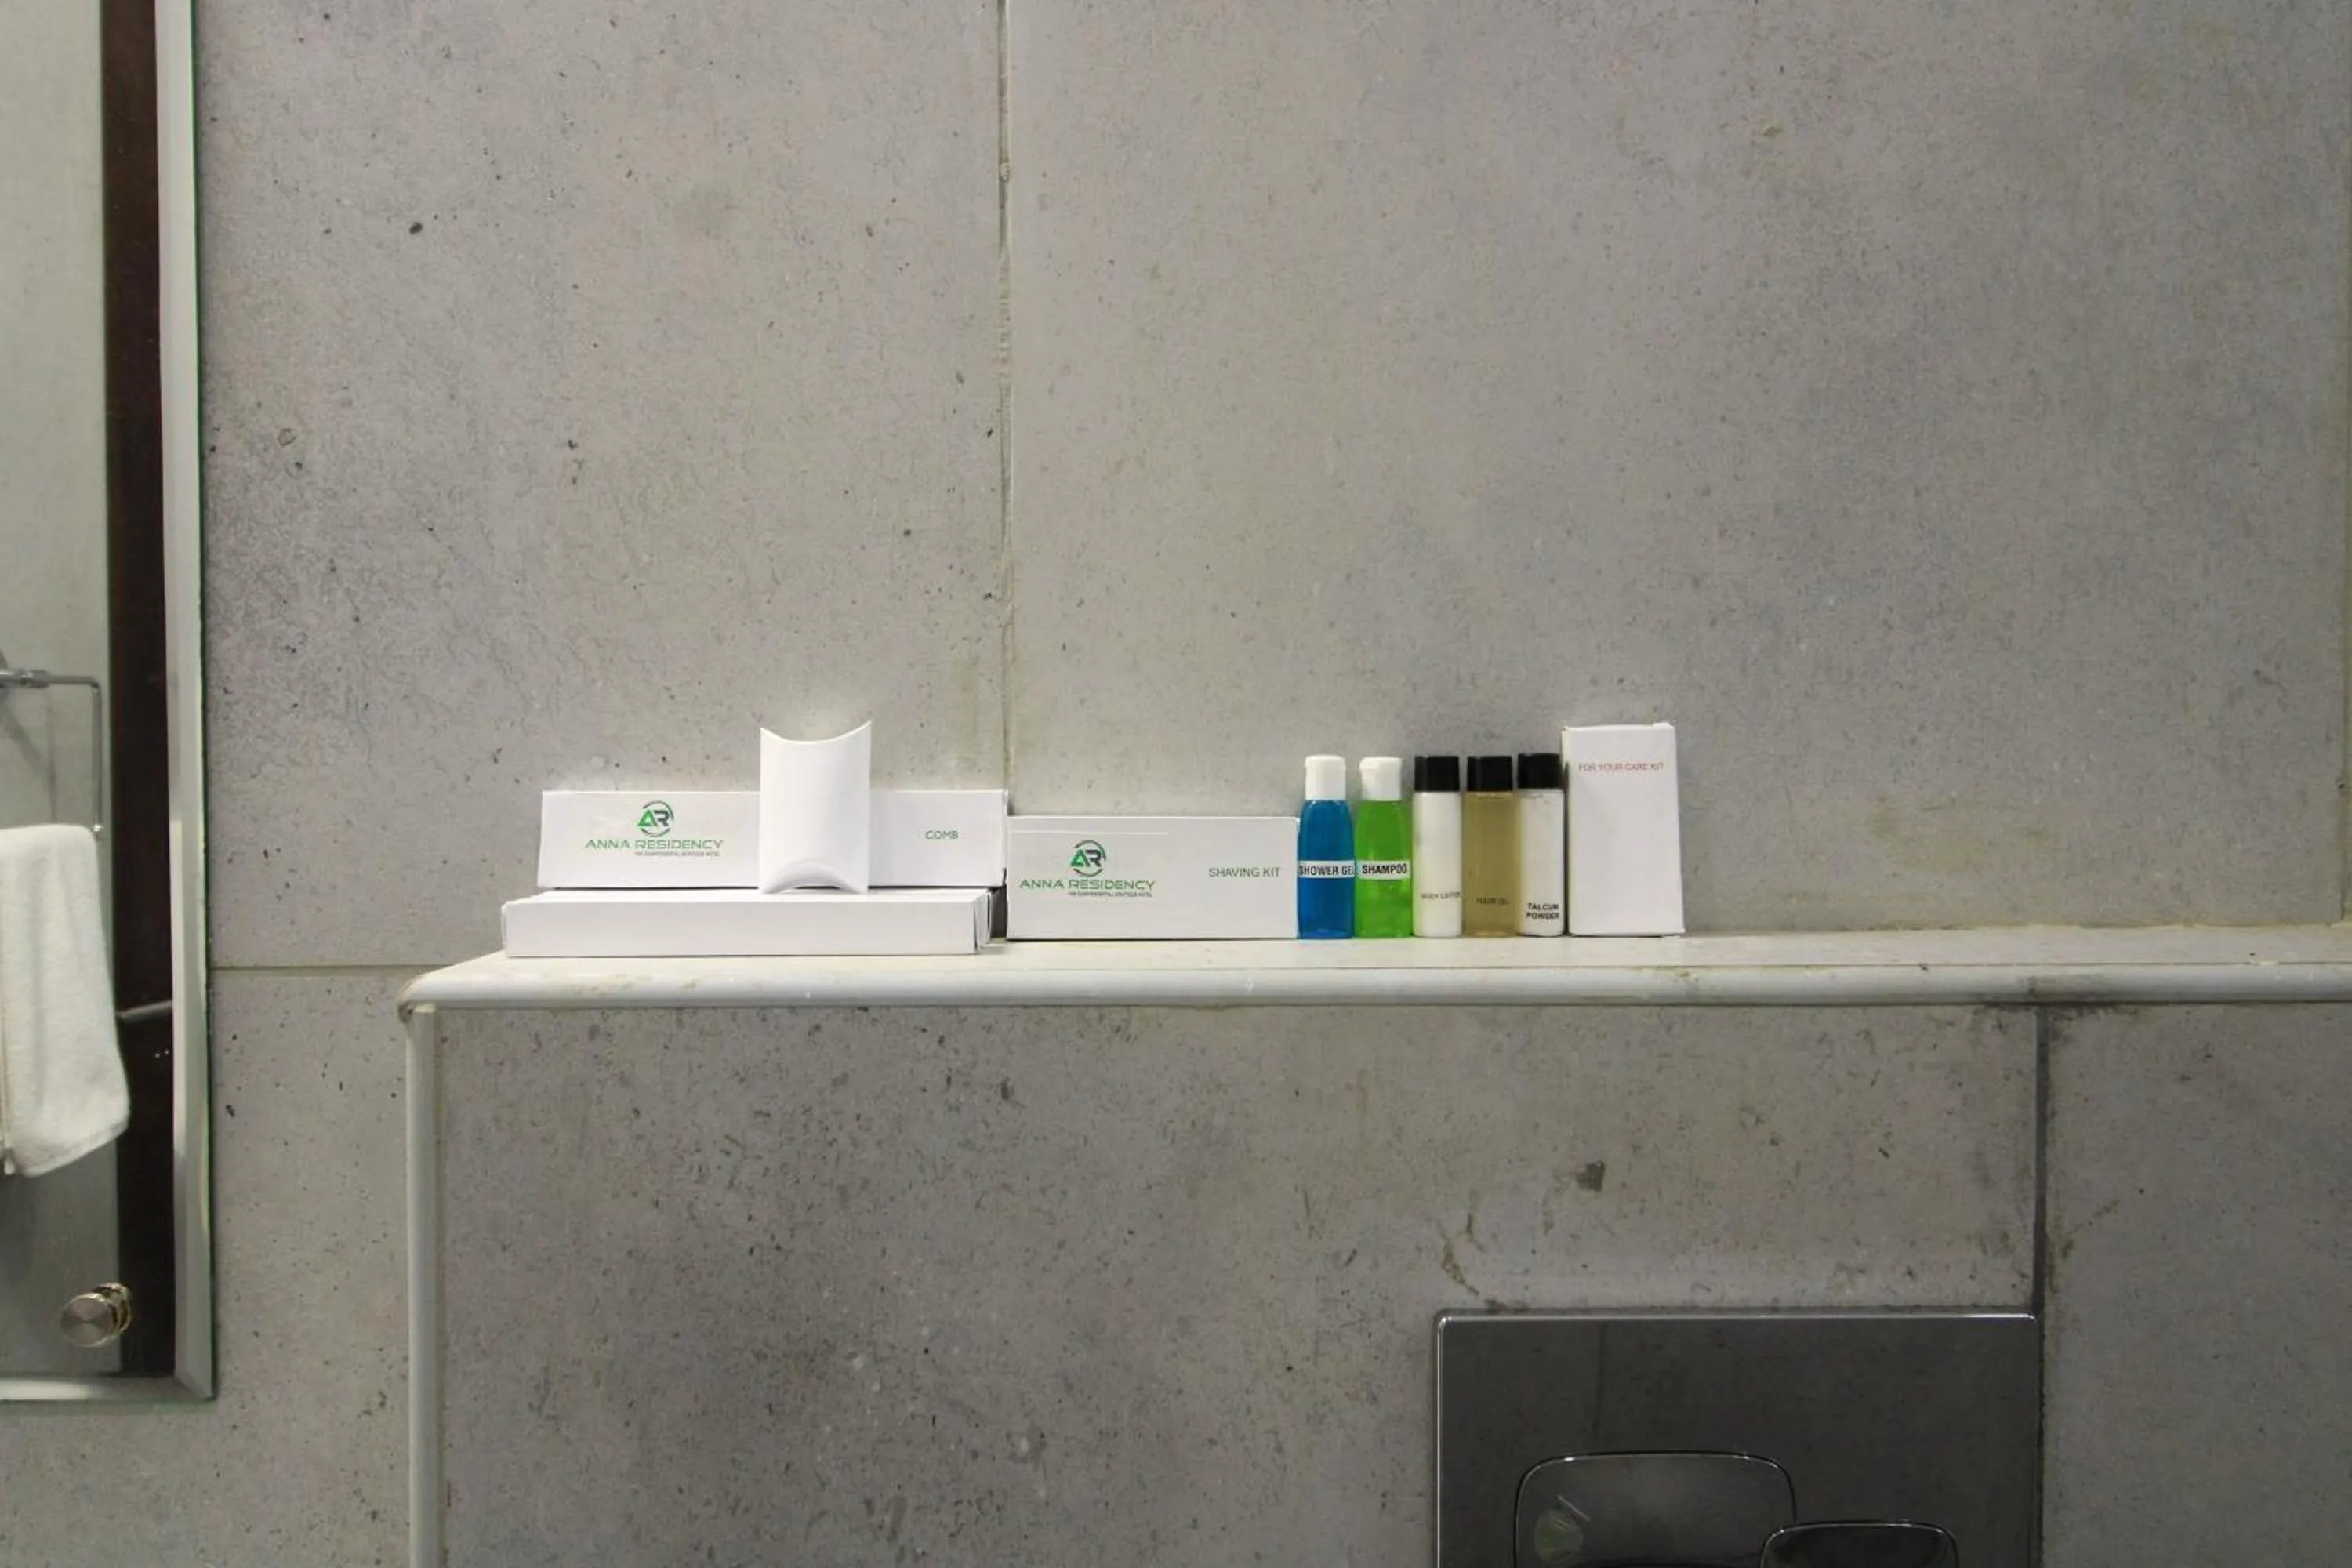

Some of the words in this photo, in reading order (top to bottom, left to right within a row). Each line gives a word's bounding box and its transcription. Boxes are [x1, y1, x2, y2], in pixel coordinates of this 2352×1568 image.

[926, 830, 959, 840] COMB
[585, 840, 630, 849] ANNA
[635, 840, 723, 849] RESIDENCY
[1208, 867, 1260, 877] SHAVING
[1262, 867, 1280, 877] KIT
[1298, 865, 1338, 875] SHOWER
[1341, 866, 1355, 875] GE
[1362, 864, 1407, 874] SHAMPOO
[1020, 879, 1064, 889] ANNA
[1068, 879, 1155, 890] RESIDENCY
[1528, 902, 1559, 911] TALCUM
